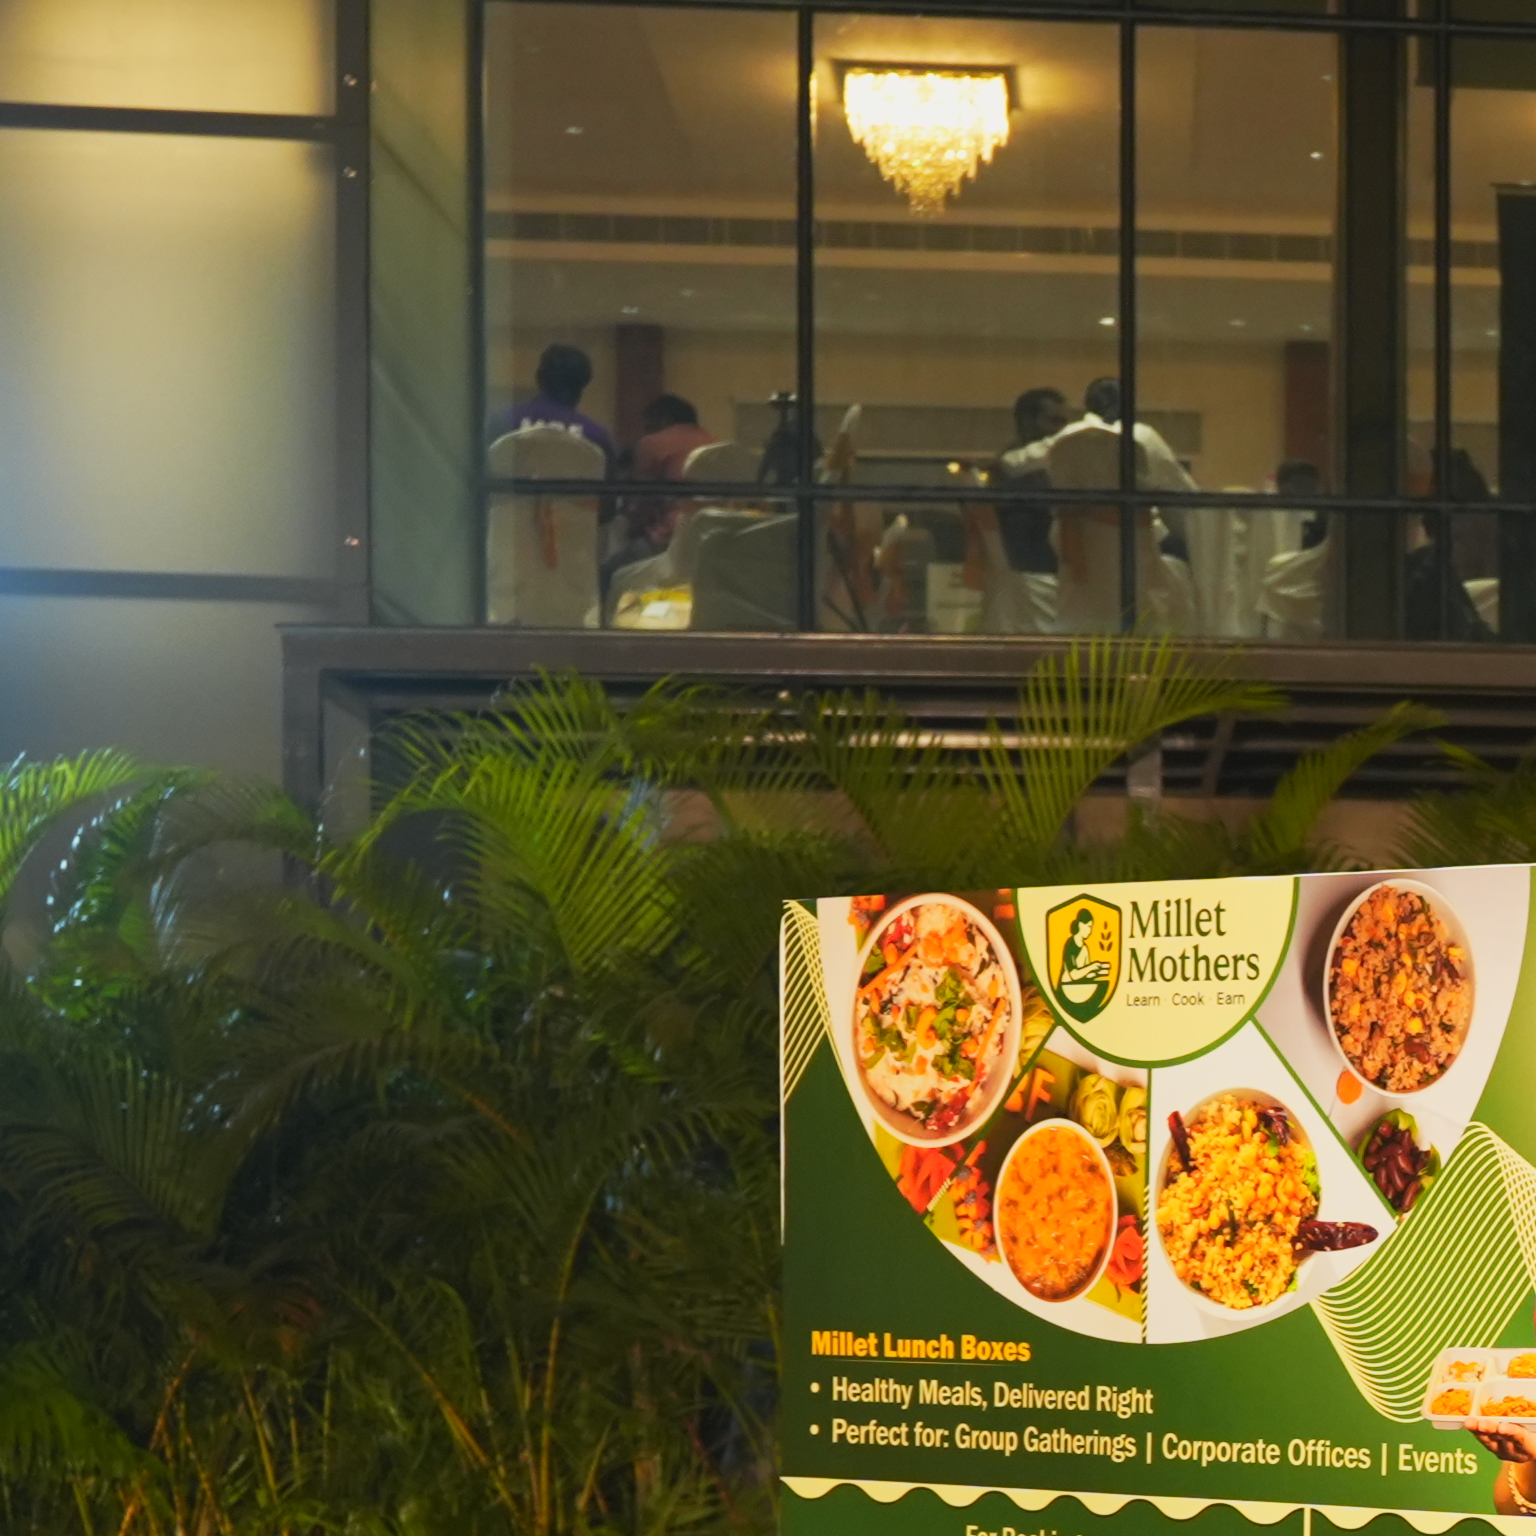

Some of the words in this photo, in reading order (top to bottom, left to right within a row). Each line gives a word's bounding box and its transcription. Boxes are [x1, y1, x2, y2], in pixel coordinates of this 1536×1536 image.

[1129, 898, 1226, 938] Millet
[1128, 944, 1260, 983] Mothers
[1126, 991, 1160, 1008] Learn
[1172, 992, 1204, 1006] Cook
[1216, 992, 1245, 1006] Earn
[811, 1330, 879, 1358] Millet
[883, 1332, 955, 1360] Lunch
[960, 1334, 1031, 1362] Boxes
[832, 1376, 914, 1410] Healthy
[919, 1378, 988, 1410] Meals,
[993, 1381, 1090, 1411] Delivered
[1096, 1385, 1154, 1419] Right
[832, 1418, 909, 1447] Perfect
[913, 1421, 949, 1448] for:
[954, 1422, 1019, 1457] Group
[1023, 1425, 1137, 1463] Gatherings
[1162, 1432, 1281, 1467] Corporate
[1287, 1438, 1372, 1470] Offices
[1398, 1443, 1479, 1475] Events
